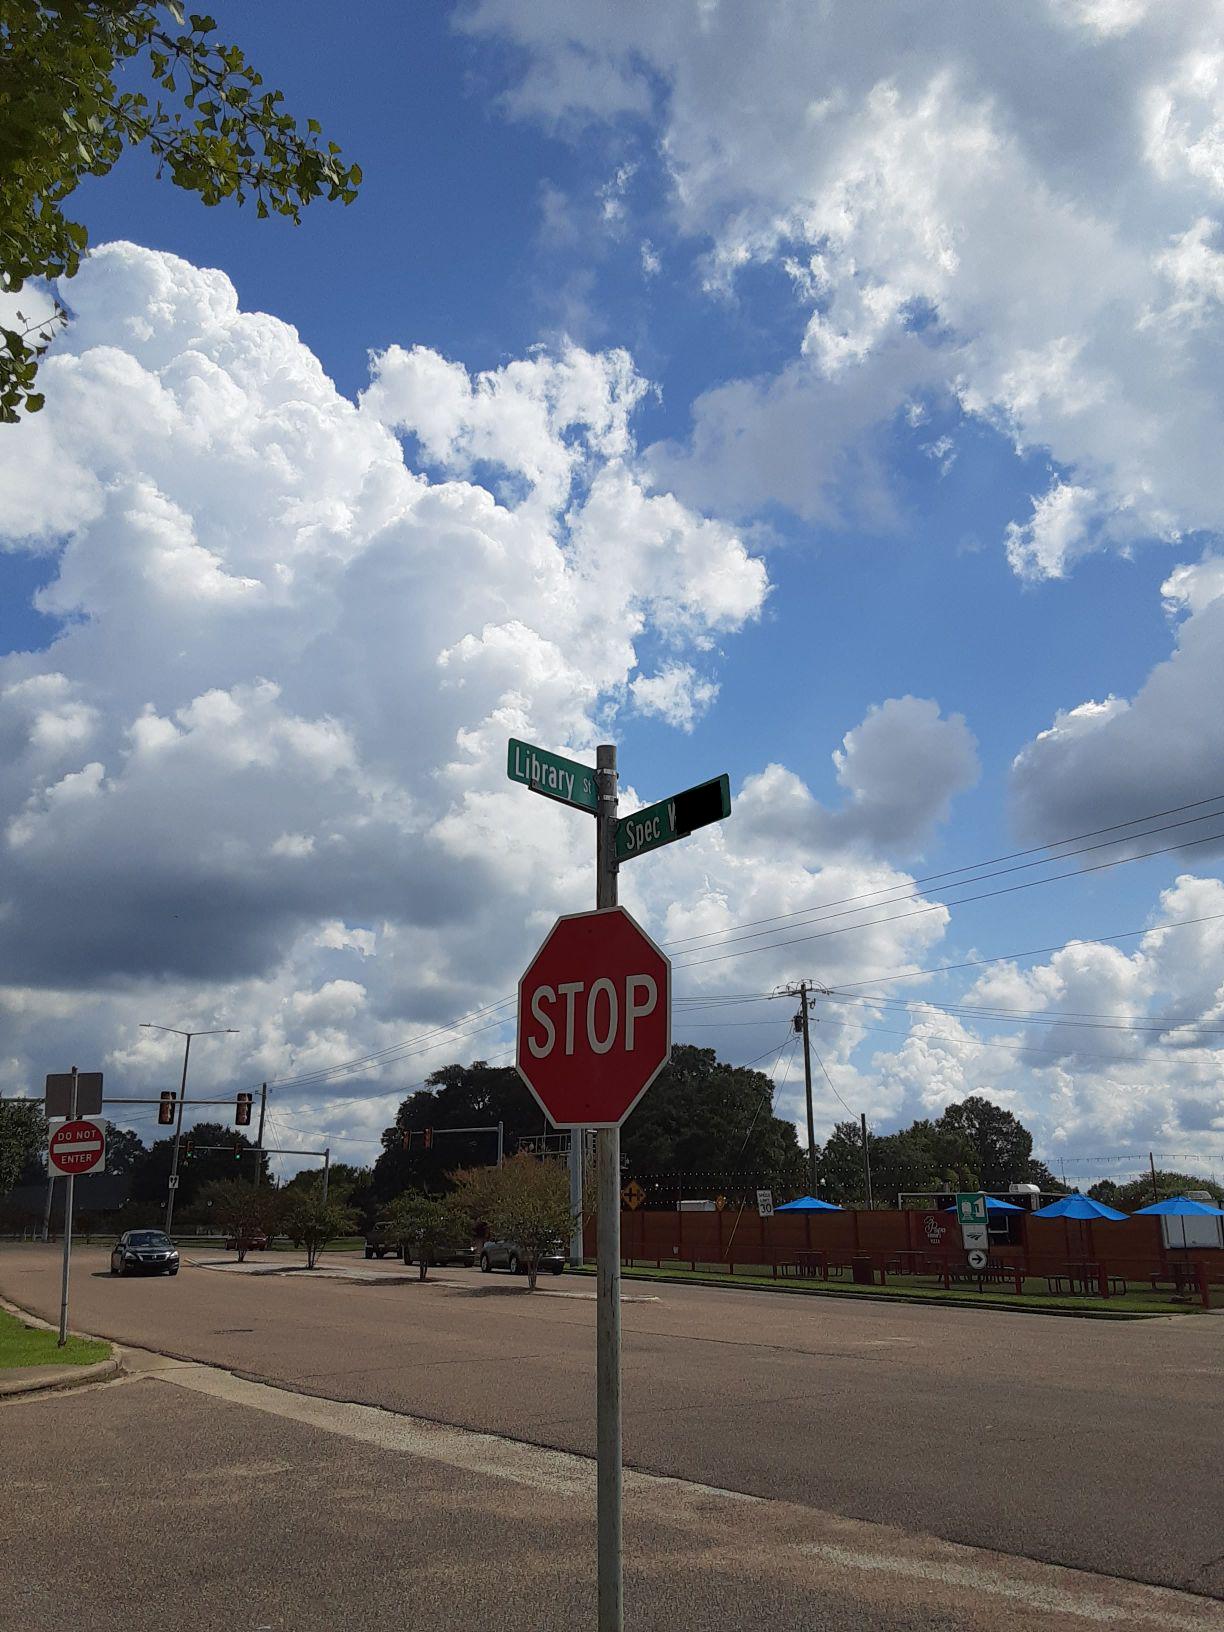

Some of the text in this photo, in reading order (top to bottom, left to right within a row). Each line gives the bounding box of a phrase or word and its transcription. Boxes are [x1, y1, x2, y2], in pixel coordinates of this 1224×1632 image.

[515, 746, 592, 800] Library St
[626, 816, 661, 850] Spec
[527, 974, 658, 1059] STOP
[58, 1130, 97, 1141] DO NOT
[61, 1153, 92, 1164] ENTER
[760, 1203, 772, 1213] 30
